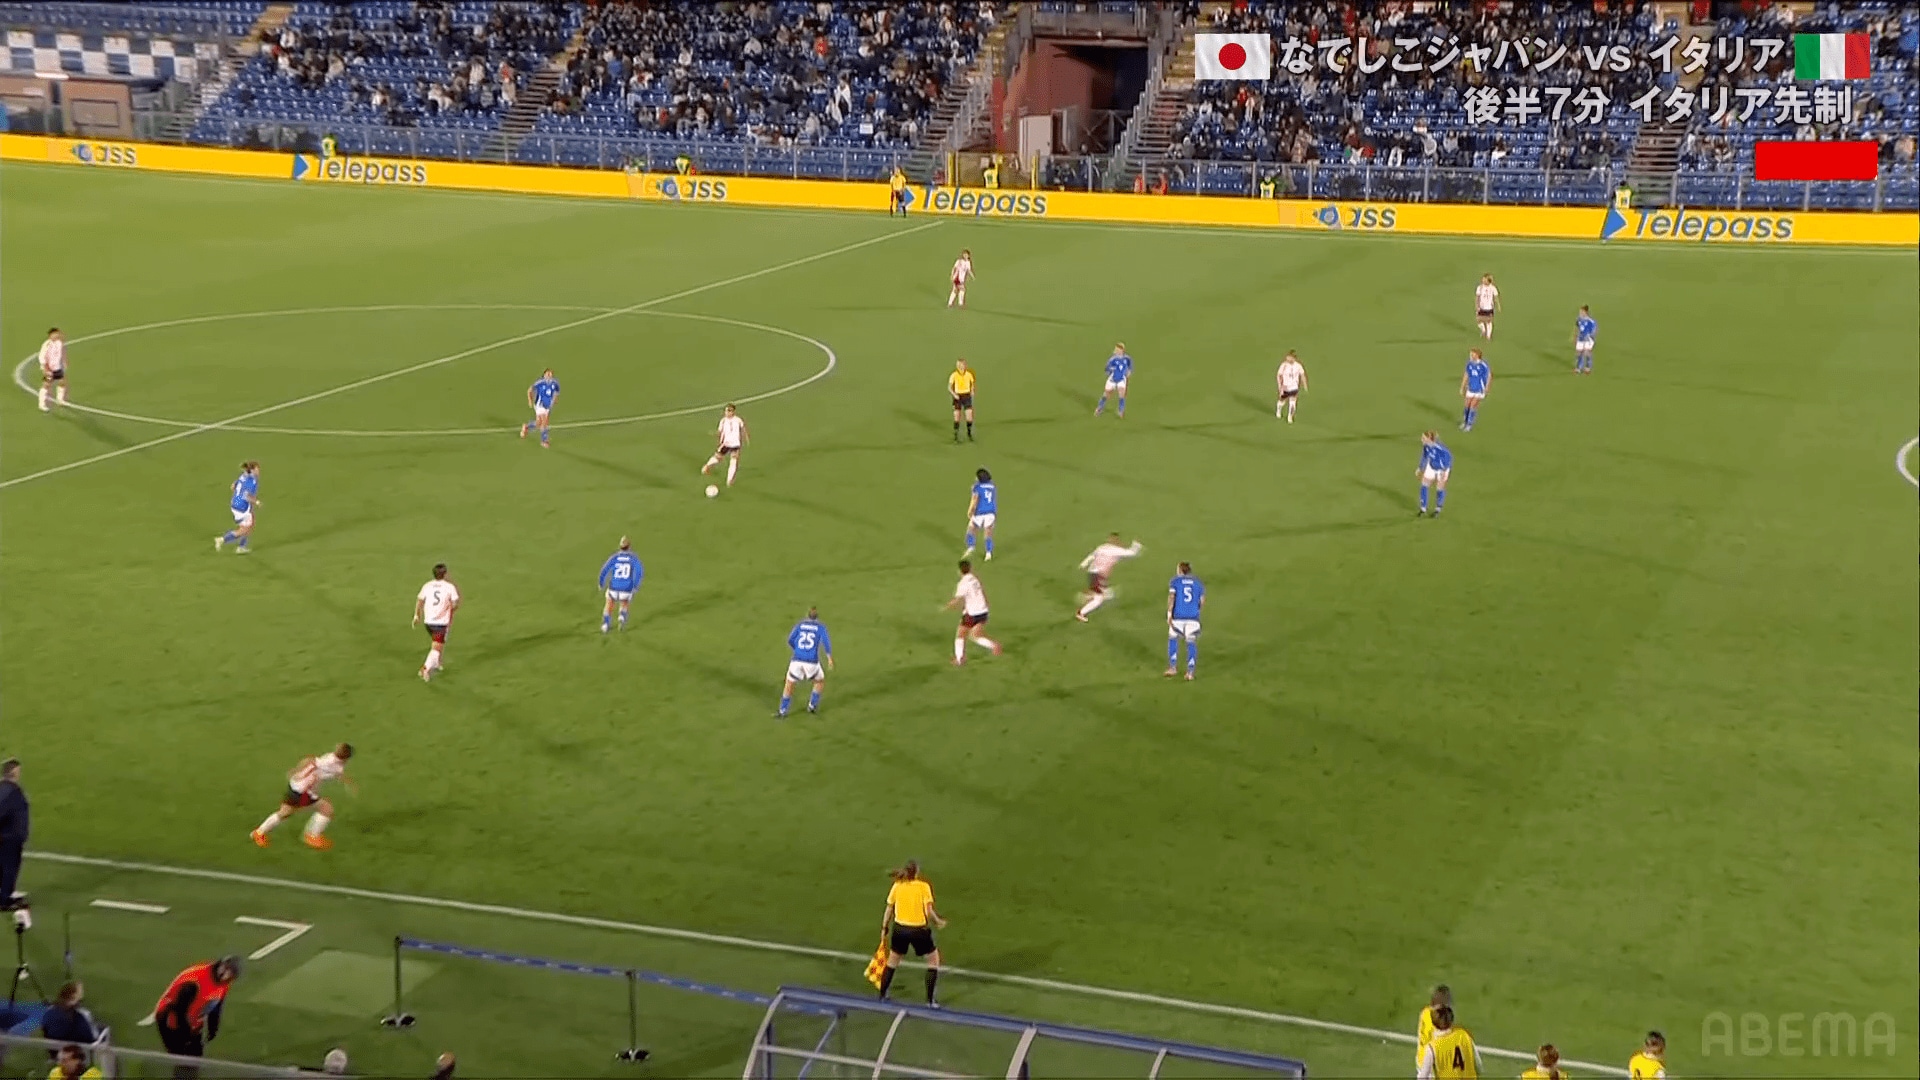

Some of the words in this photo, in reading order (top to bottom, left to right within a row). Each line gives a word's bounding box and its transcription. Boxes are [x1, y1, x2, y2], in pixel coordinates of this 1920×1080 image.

[922, 184, 1047, 220] Telepass
[1636, 206, 1794, 243] Telepass
[984, 489, 993, 504] 4
[614, 562, 631, 579] 20
[433, 590, 441, 606] 5
[1183, 587, 1193, 602] 5
[797, 631, 816, 650] 25
[1453, 1046, 1464, 1071] A
